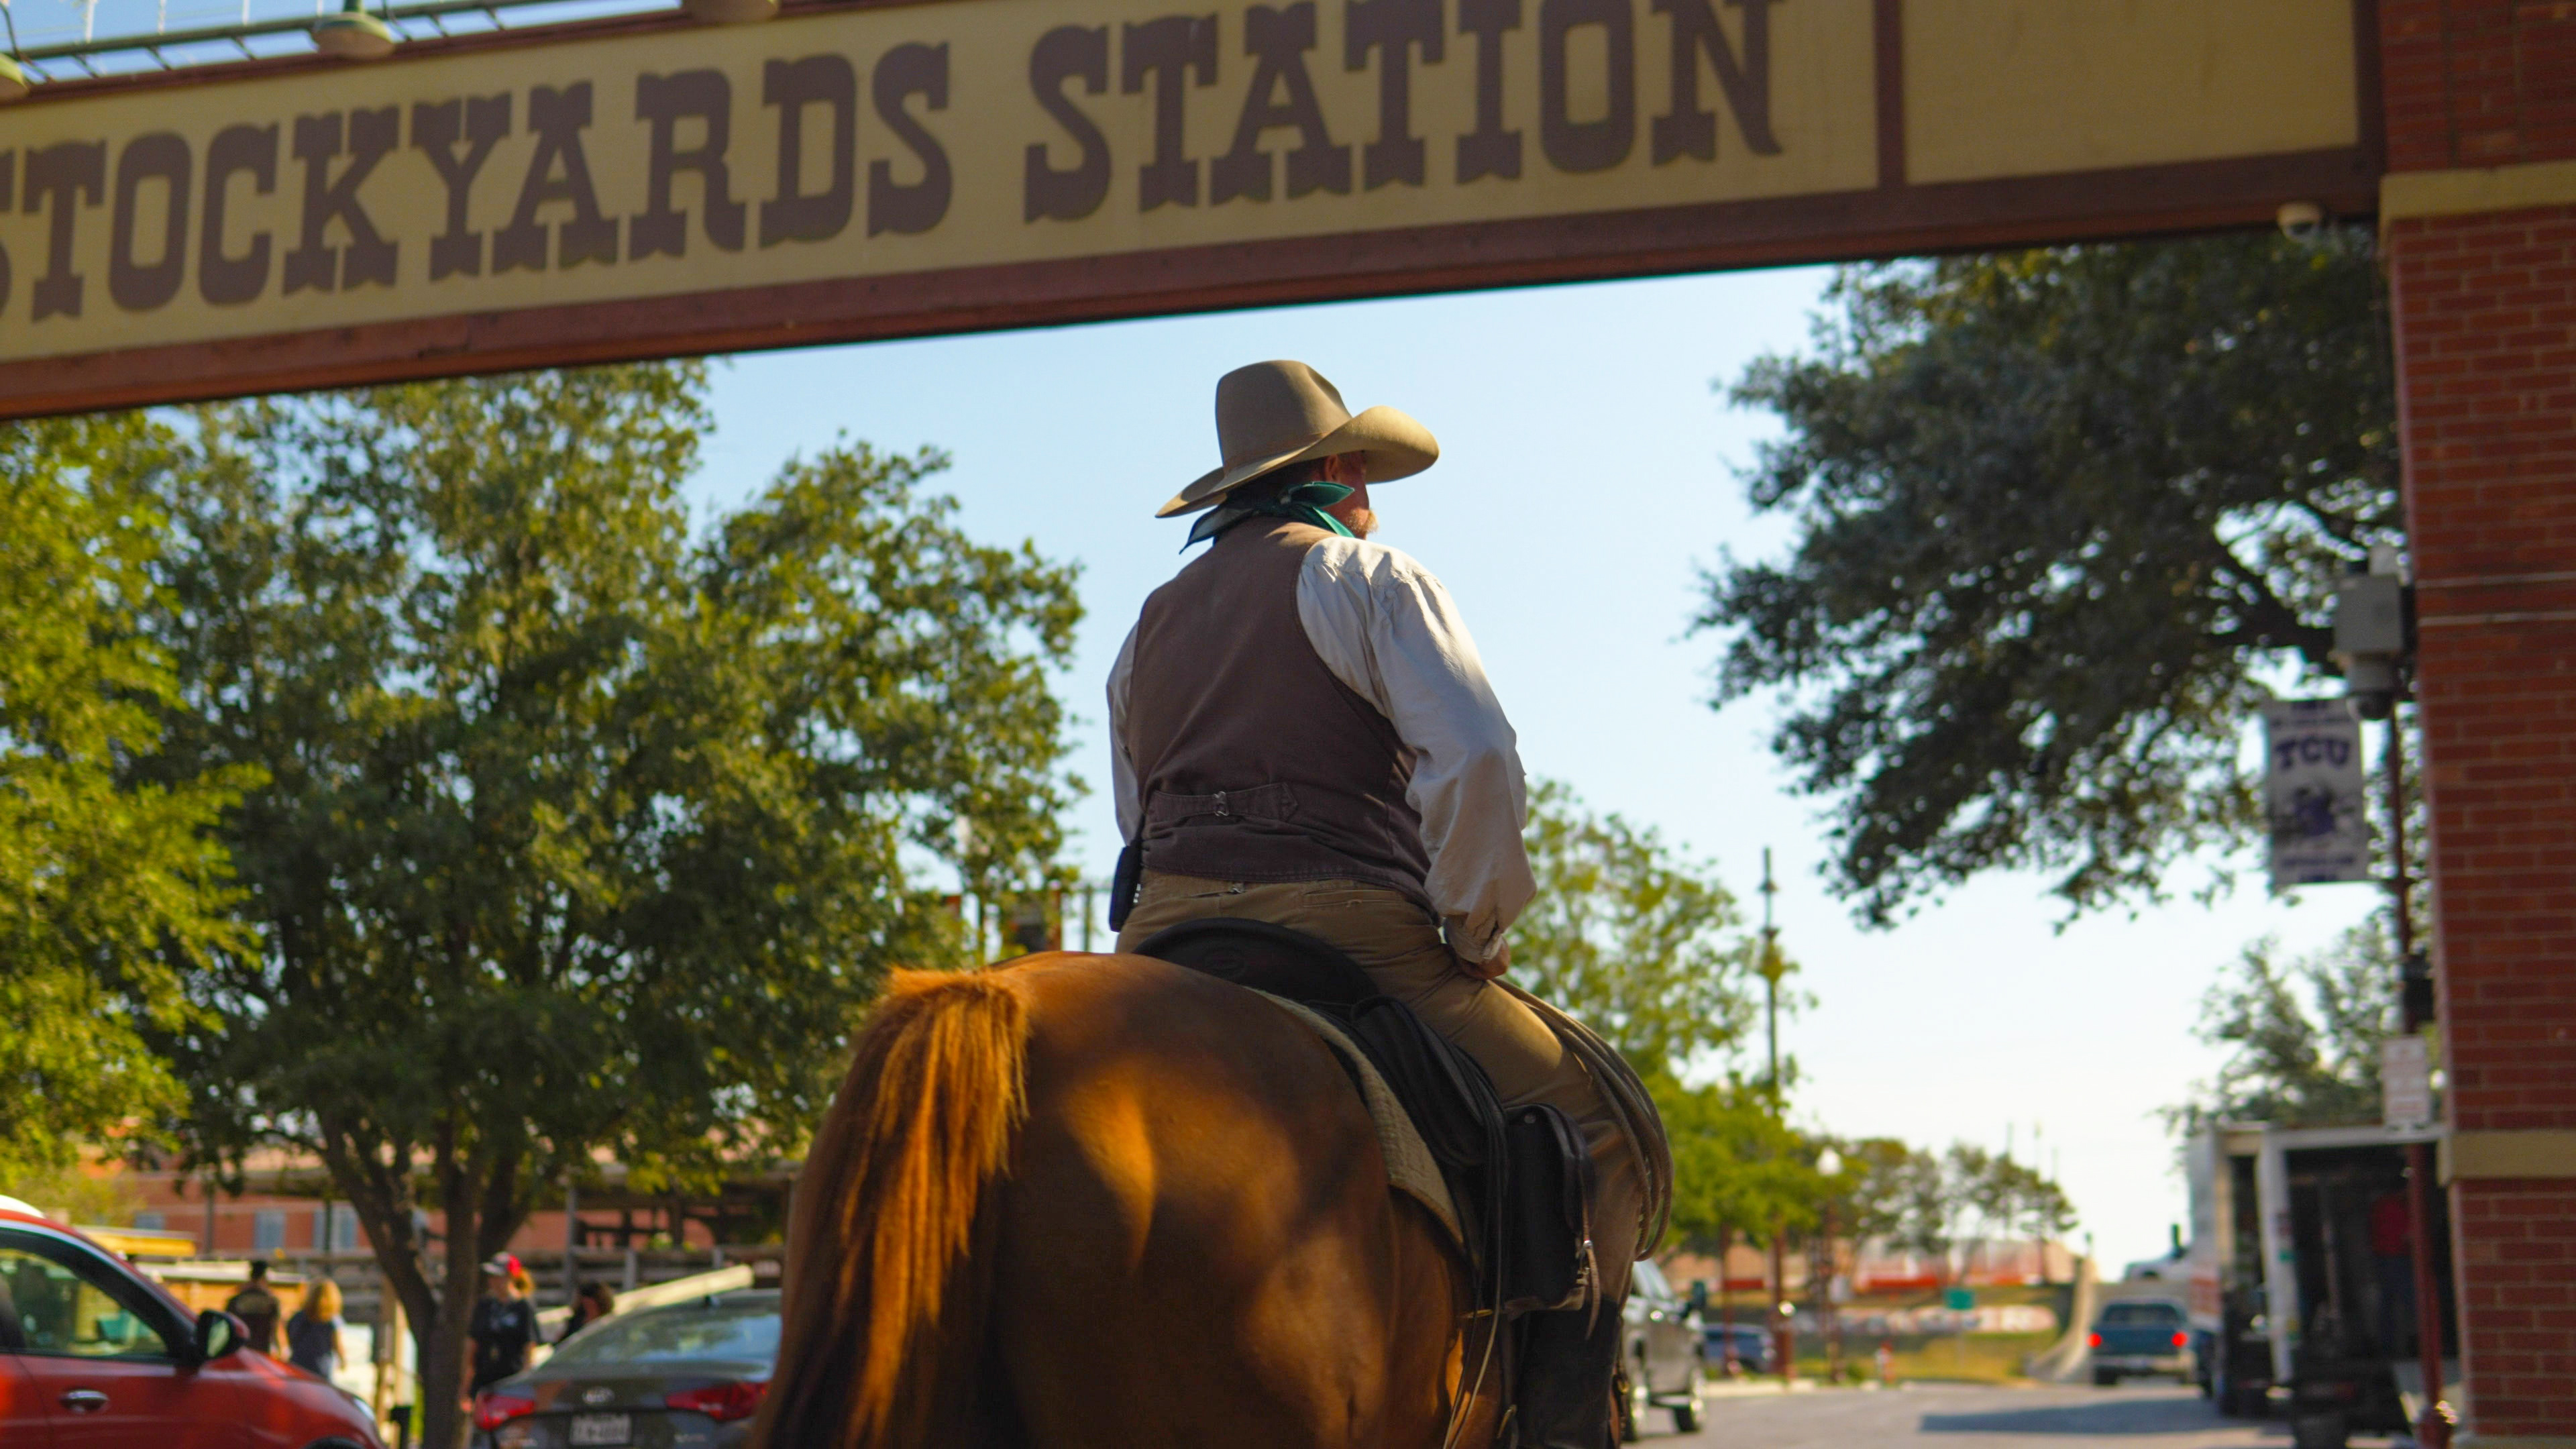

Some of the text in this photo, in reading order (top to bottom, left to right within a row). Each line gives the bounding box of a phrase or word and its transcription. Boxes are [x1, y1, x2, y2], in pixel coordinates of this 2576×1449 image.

[0, 0, 1784, 323] TOCKYARDS STATION
[2275, 736, 2350, 769] TCU
